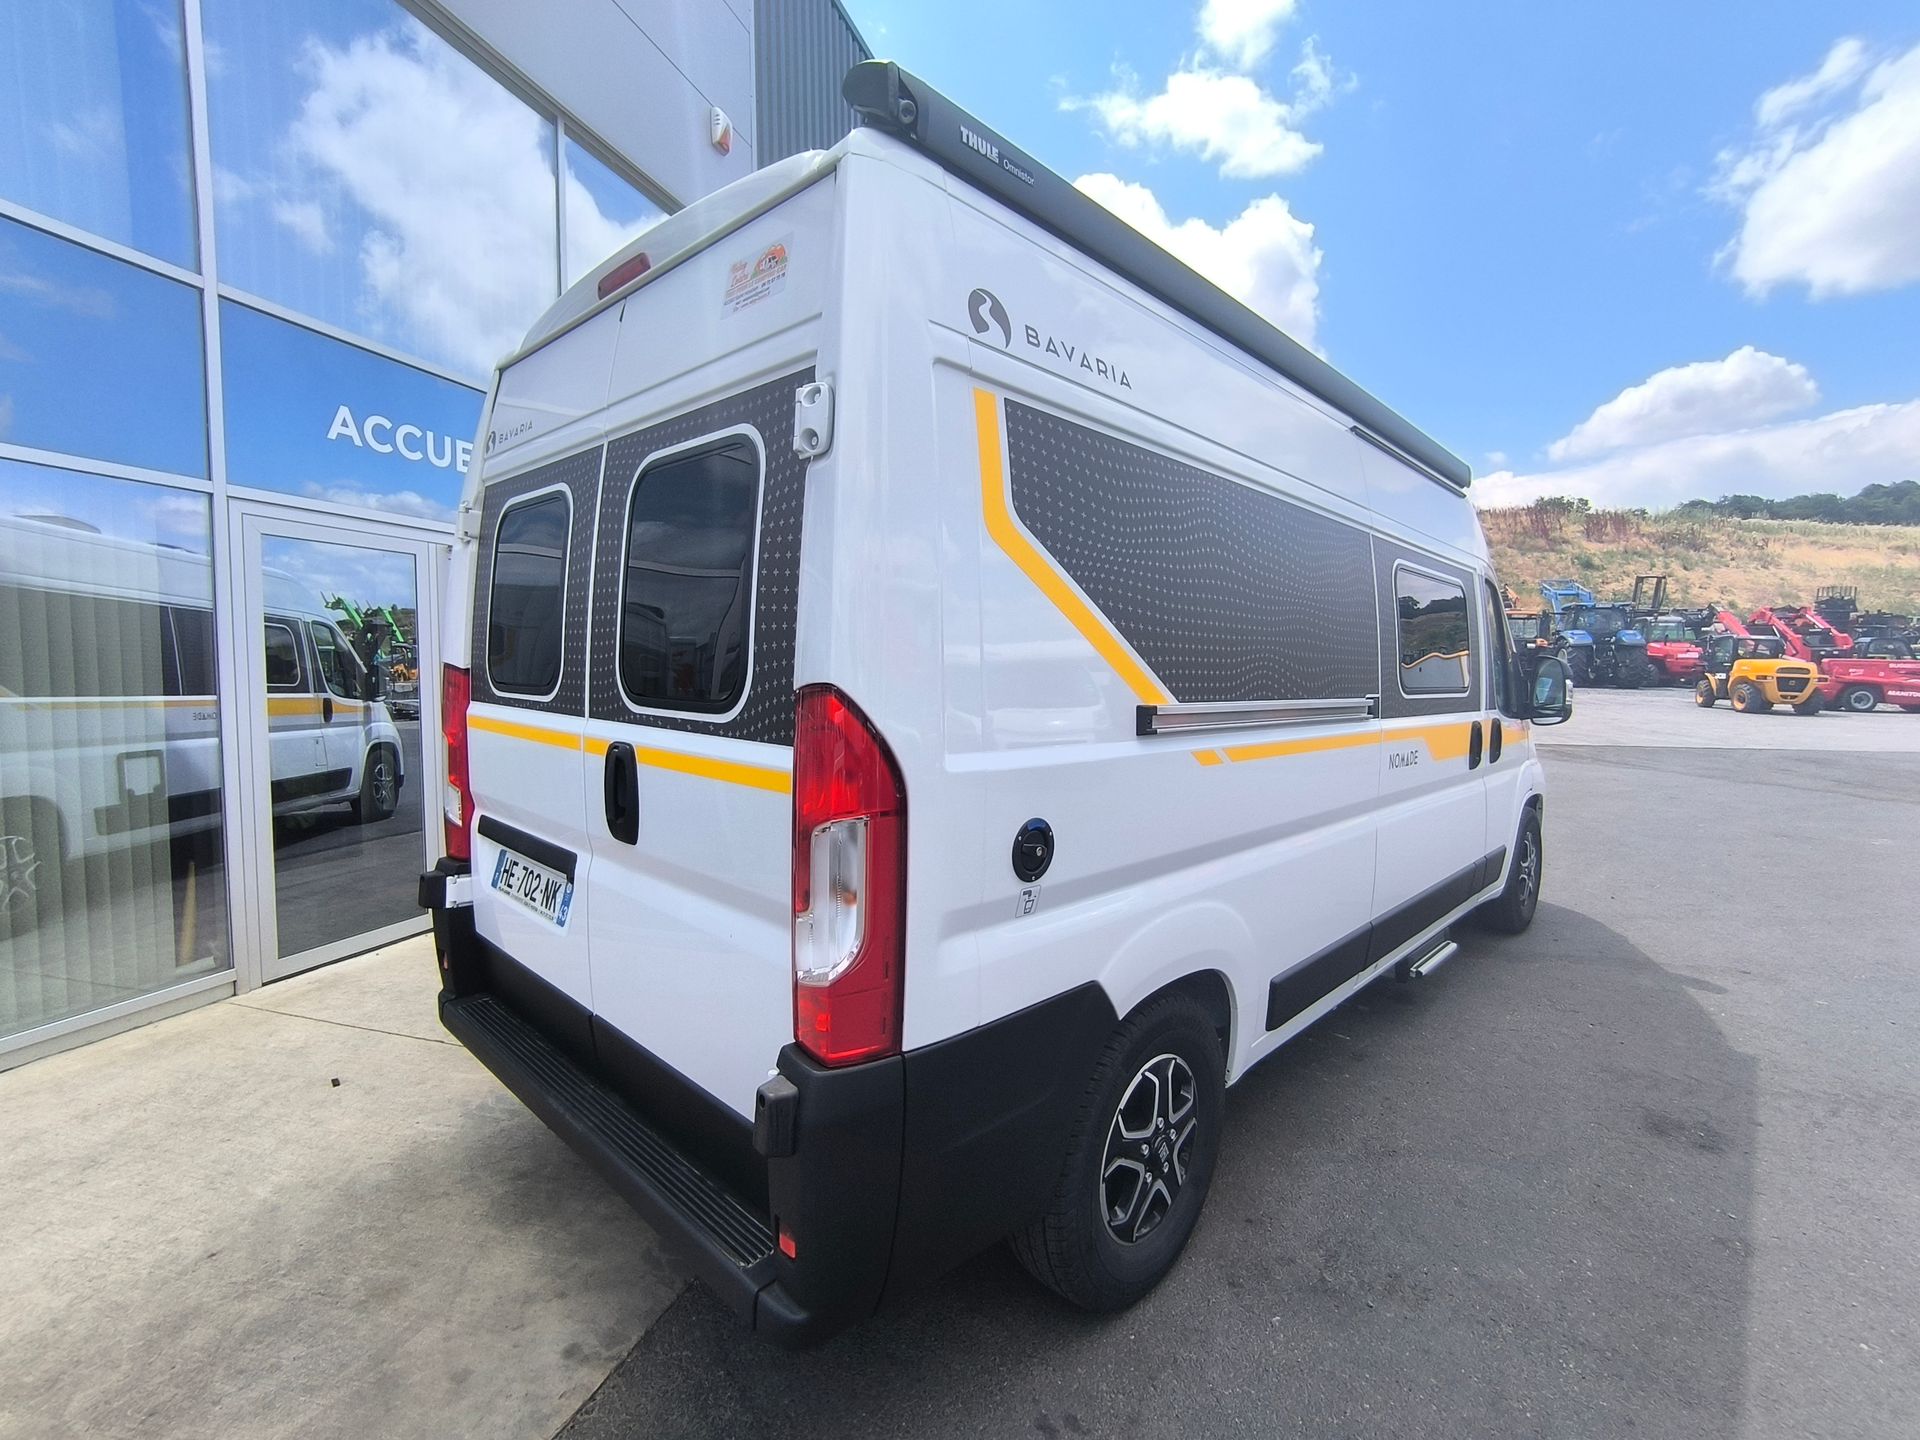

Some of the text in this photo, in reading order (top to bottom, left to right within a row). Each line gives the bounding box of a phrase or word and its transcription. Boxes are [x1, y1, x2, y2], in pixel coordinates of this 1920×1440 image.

[960, 125, 1034, 185] THULE Omnistor
[1025, 324, 1132, 390] BAVARIA
[499, 420, 533, 444] BAVARIA
[1388, 750, 1418, 770] NOMADE
